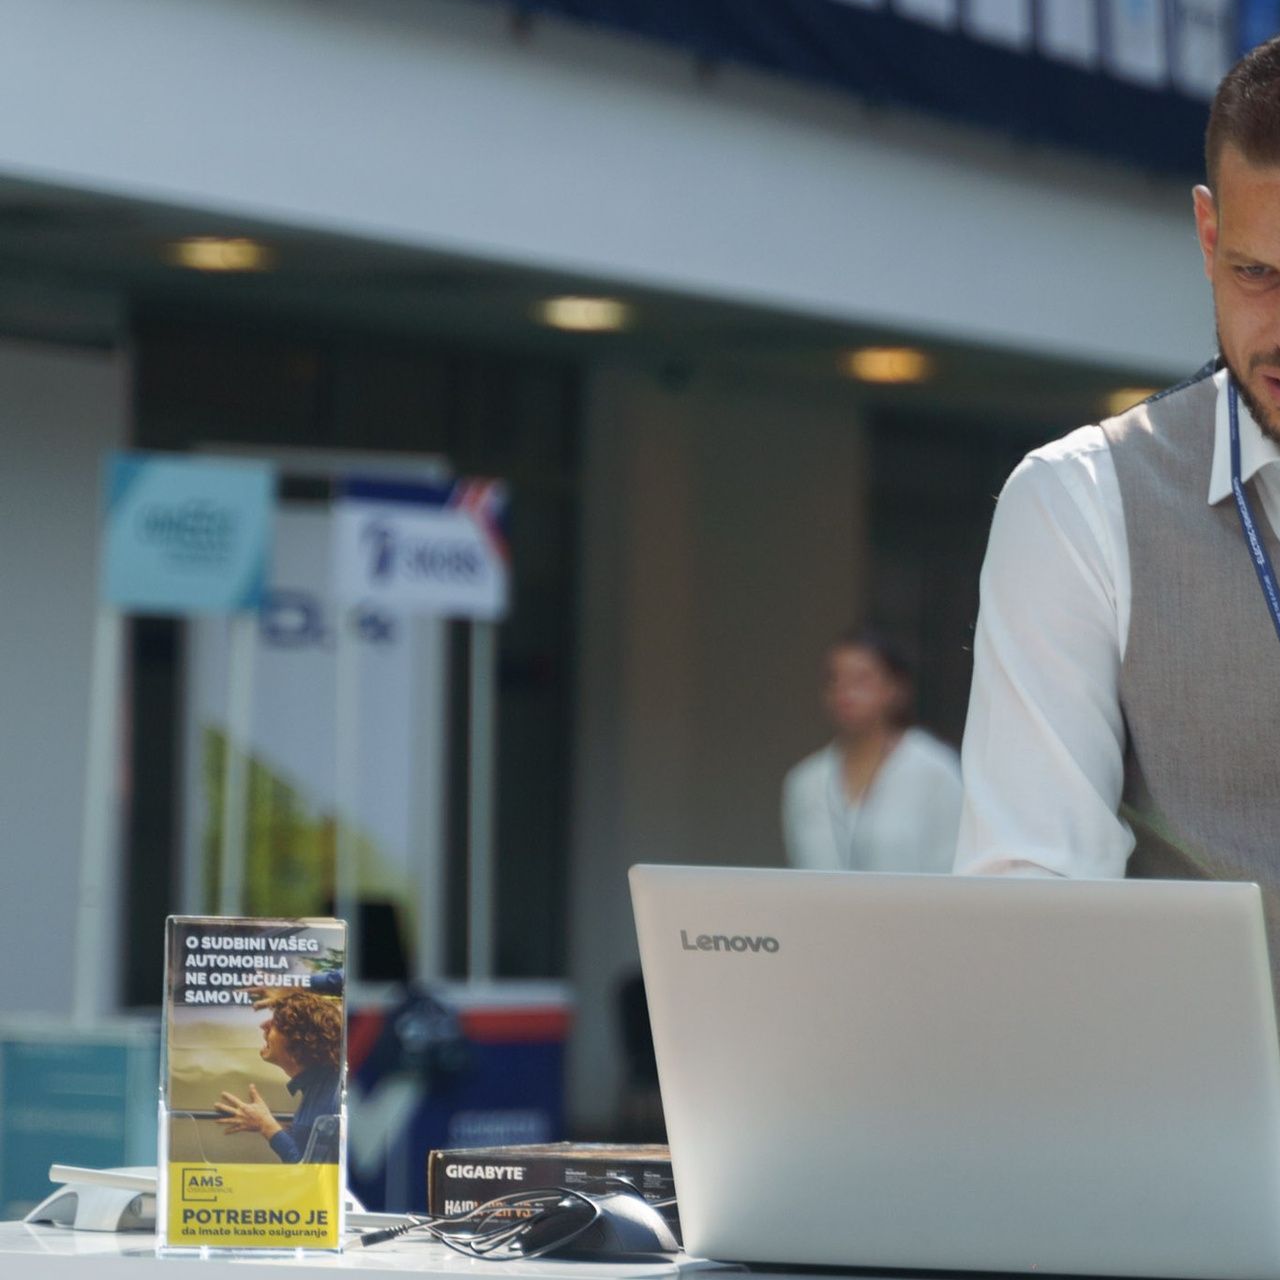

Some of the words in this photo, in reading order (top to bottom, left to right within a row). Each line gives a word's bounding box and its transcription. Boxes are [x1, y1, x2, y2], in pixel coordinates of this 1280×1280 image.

[186, 936, 199, 949] O
[201, 936, 266, 951] SUDBINI
[268, 935, 319, 952] VAŠEG
[680, 929, 780, 953] Lenovo
[185, 954, 289, 969] AUTOMOBILA
[185, 972, 207, 985] NE
[210, 971, 311, 987] ODLUČUJETE
[185, 990, 230, 1003] SAMO
[232, 991, 252, 1004] VI.
[445, 1164, 524, 1180] GIGABYTE
[188, 1176, 223, 1187] AMS
[182, 1209, 301, 1225] POTREBNO
[305, 1210, 328, 1225] JE
[182, 1226, 196, 1236] da
[199, 1226, 231, 1236] imate
[234, 1227, 266, 1237] kasko
[269, 1227, 328, 1239] osiguranje
